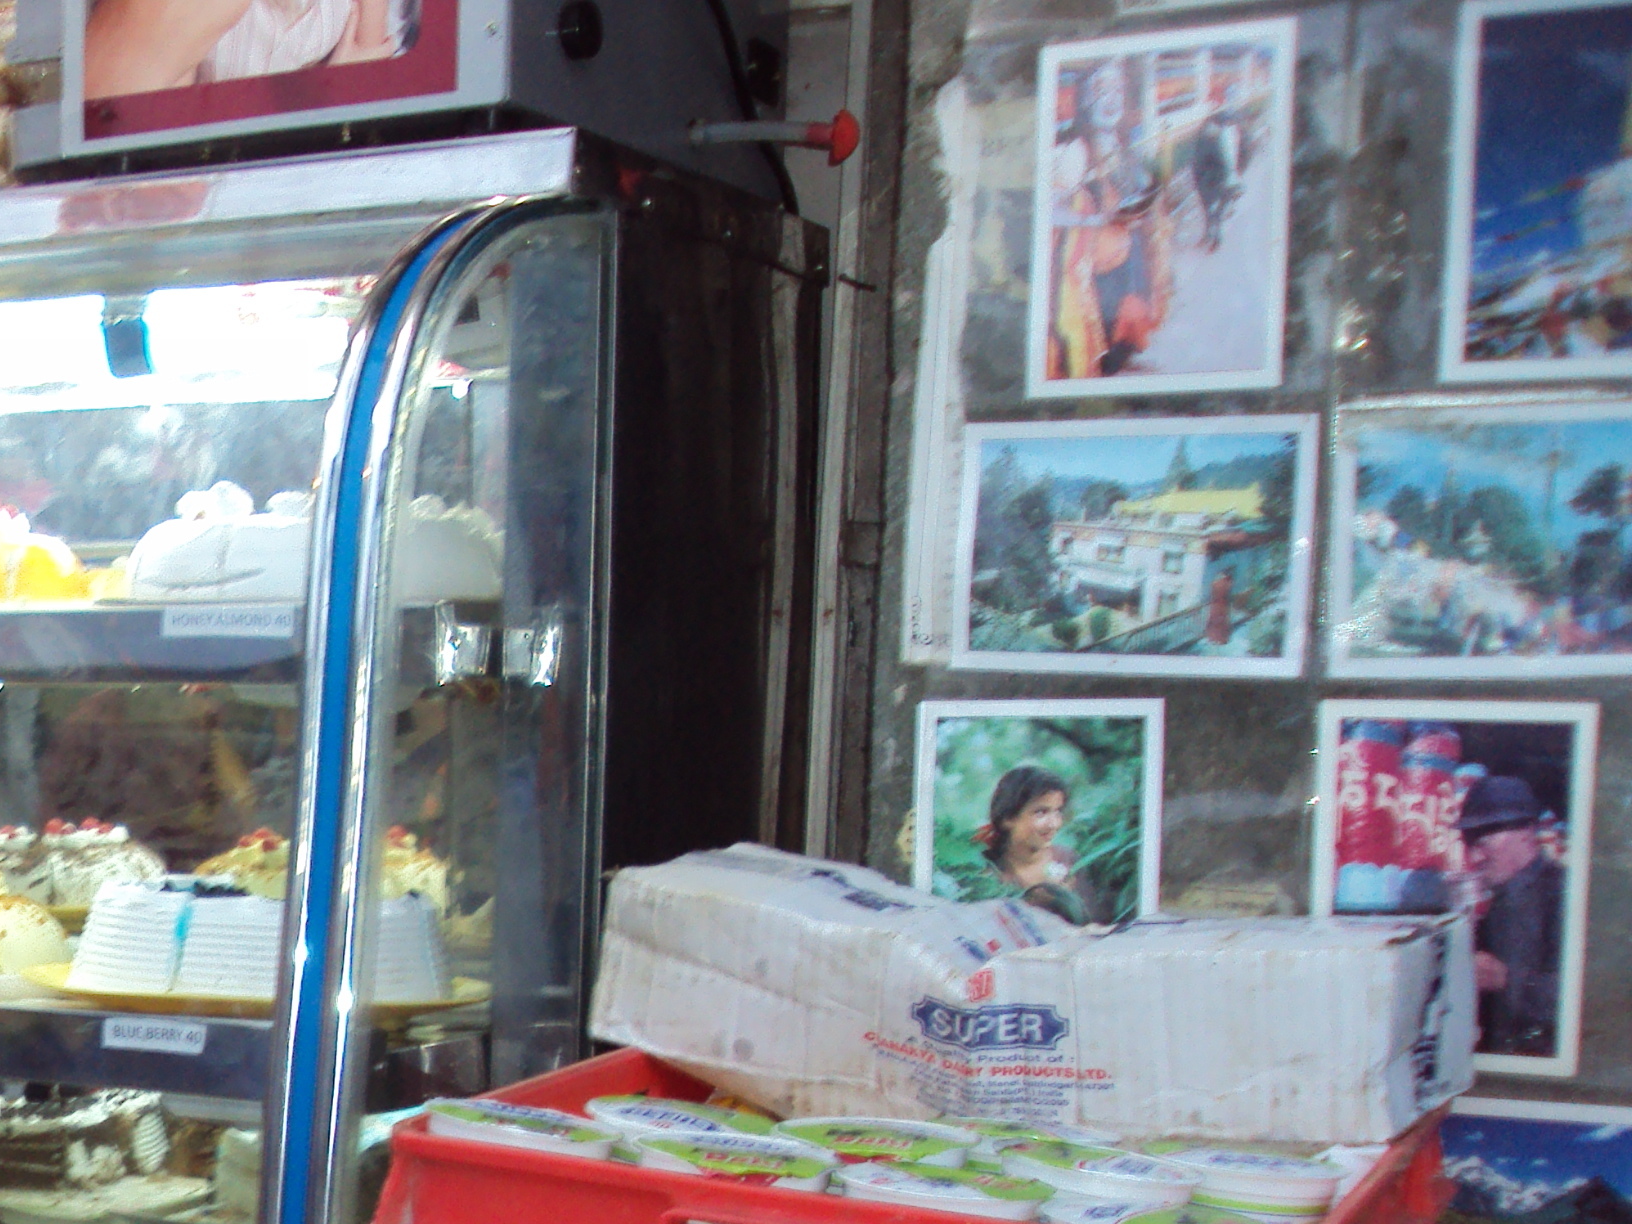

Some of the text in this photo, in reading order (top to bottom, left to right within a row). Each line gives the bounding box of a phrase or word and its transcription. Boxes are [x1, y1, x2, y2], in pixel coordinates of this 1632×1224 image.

[171, 612, 212, 627] HONEY
[213, 612, 272, 627] ALMOND
[113, 1024, 143, 1038] BLUE
[146, 1026, 183, 1041] BERRY
[929, 1007, 1044, 1043] SUPER
[978, 1053, 1041, 1063] Product
[990, 1065, 1074, 1079] PRODUCTS
[1076, 1067, 1113, 1080] LTD.
